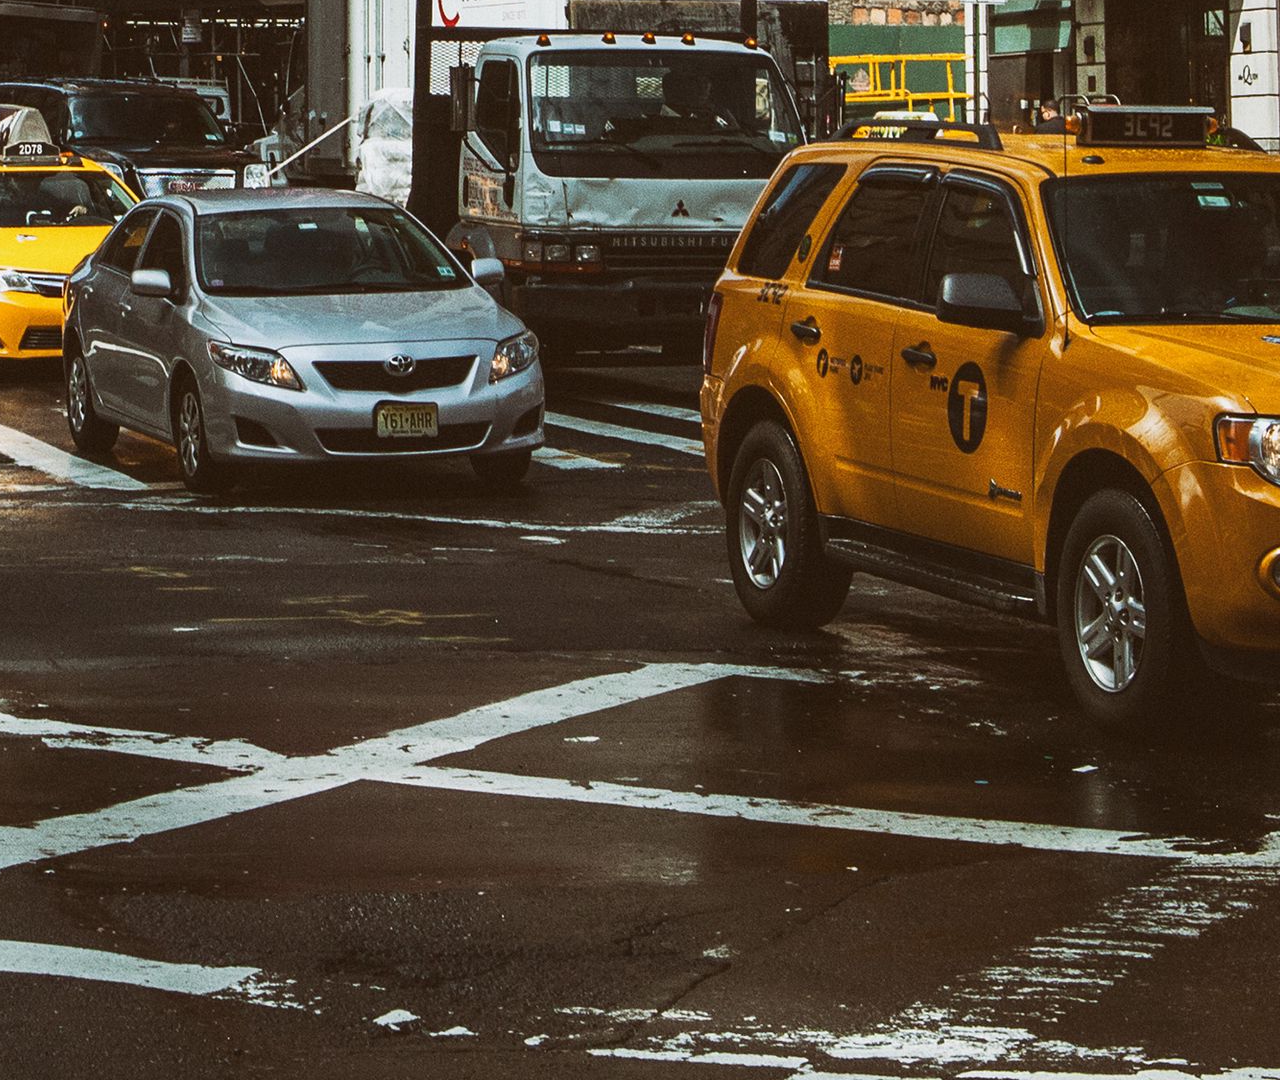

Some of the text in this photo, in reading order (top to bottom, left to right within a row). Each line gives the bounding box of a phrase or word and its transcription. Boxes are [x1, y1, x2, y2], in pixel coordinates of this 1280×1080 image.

[1124, 114, 1172, 137] 3C92
[19, 144, 42, 155] 2D78
[612, 237, 703, 247] MITSUBISHI
[930, 376, 949, 392] NYC
[957, 380, 980, 441] T
